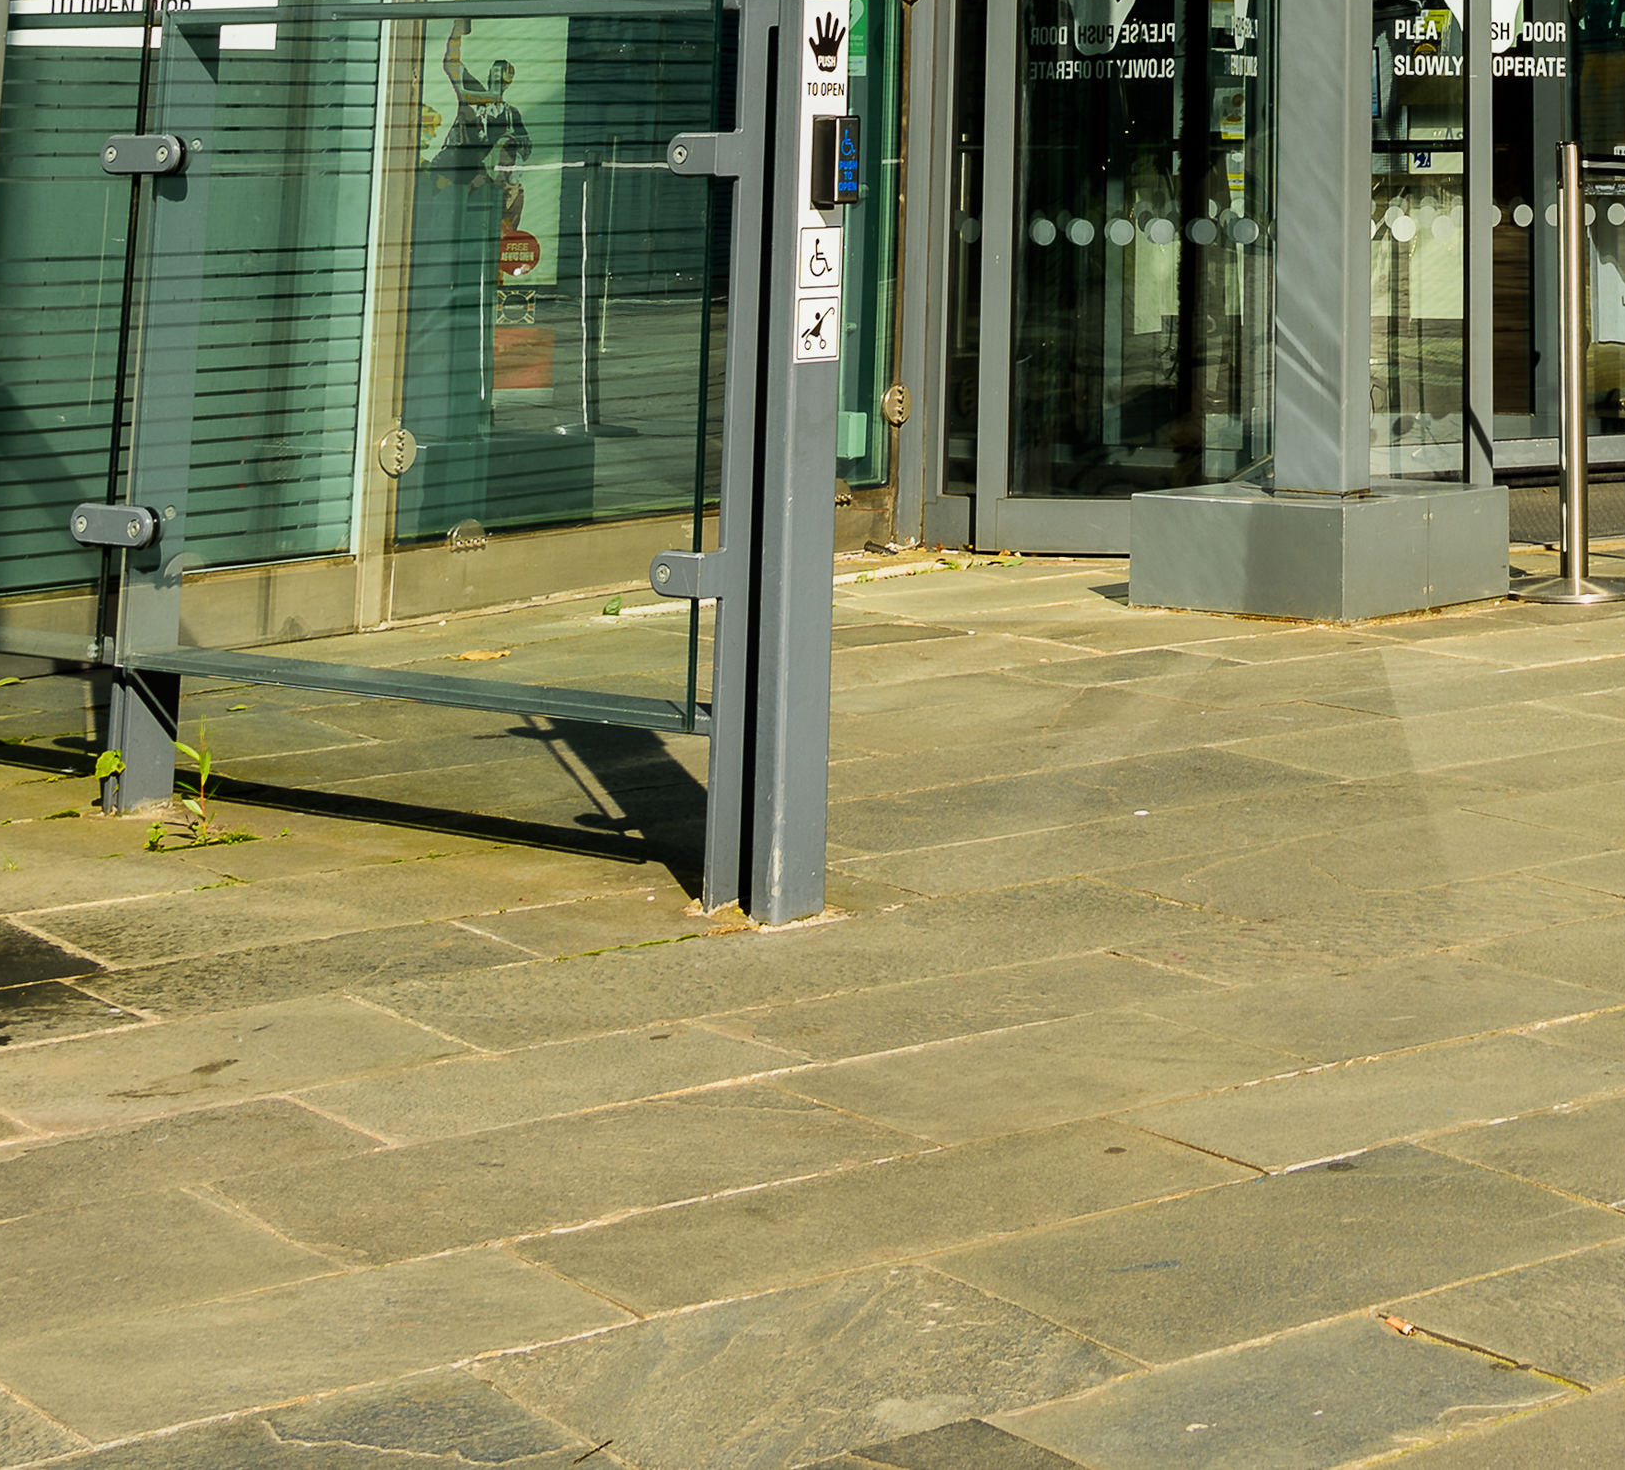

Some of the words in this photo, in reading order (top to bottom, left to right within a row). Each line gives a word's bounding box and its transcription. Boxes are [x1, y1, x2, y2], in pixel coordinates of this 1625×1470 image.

[1395, 19, 1438, 40] PLEA
[1523, 21, 1567, 43] DOOR
[818, 55, 837, 68] PUSH
[1394, 54, 1463, 77] SLOWLY
[1493, 55, 1567, 78] OPERATE
[807, 82, 818, 96] TO
[820, 82, 845, 97] OPEN
[838, 160, 857, 170] PUSH
[844, 171, 853, 180] TO
[838, 181, 857, 191] OPEN
